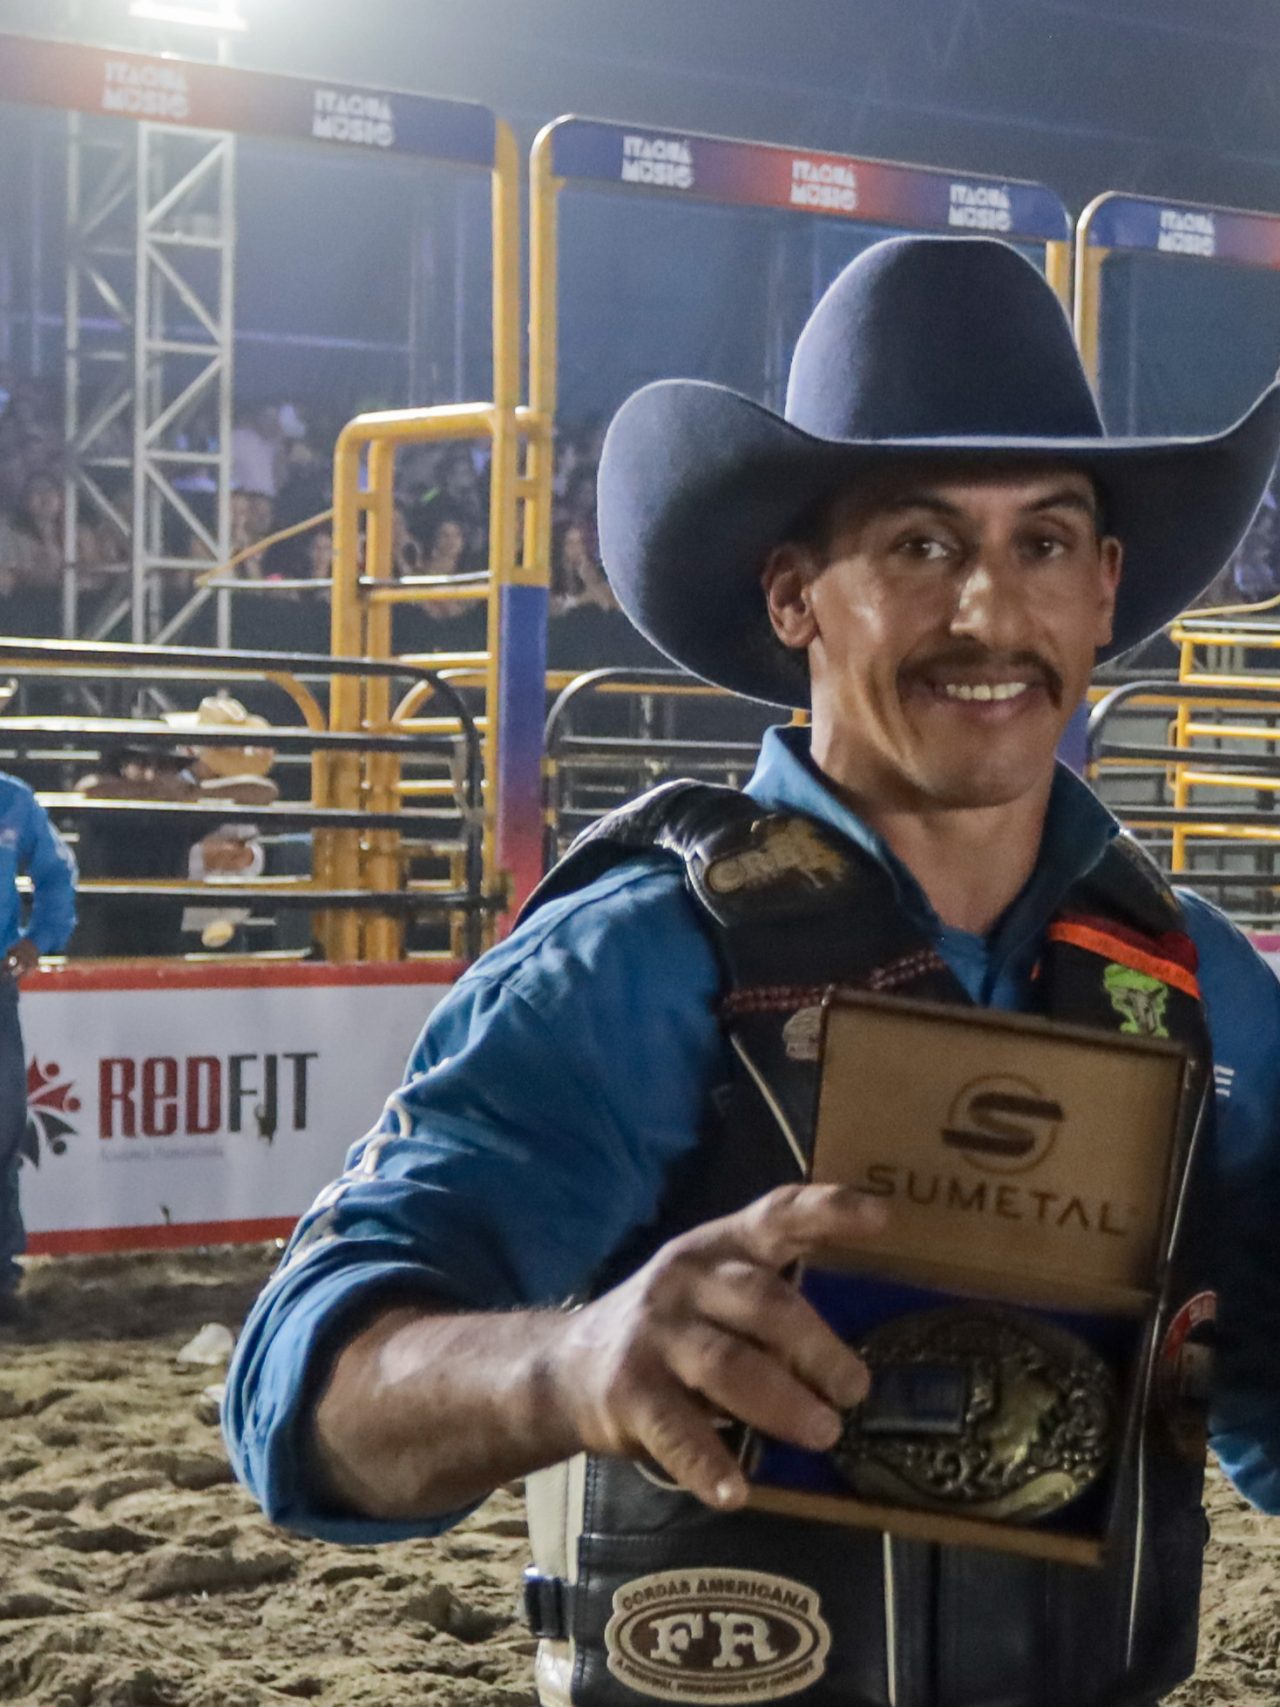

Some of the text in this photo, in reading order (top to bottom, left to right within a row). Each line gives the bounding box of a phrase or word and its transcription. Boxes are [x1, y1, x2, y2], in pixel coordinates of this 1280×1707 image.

[857, 1162, 1128, 1236] SUMETAL
[622, 1578, 810, 1614] CORDAS AMERICANA
[649, 1610, 778, 1668] FR
